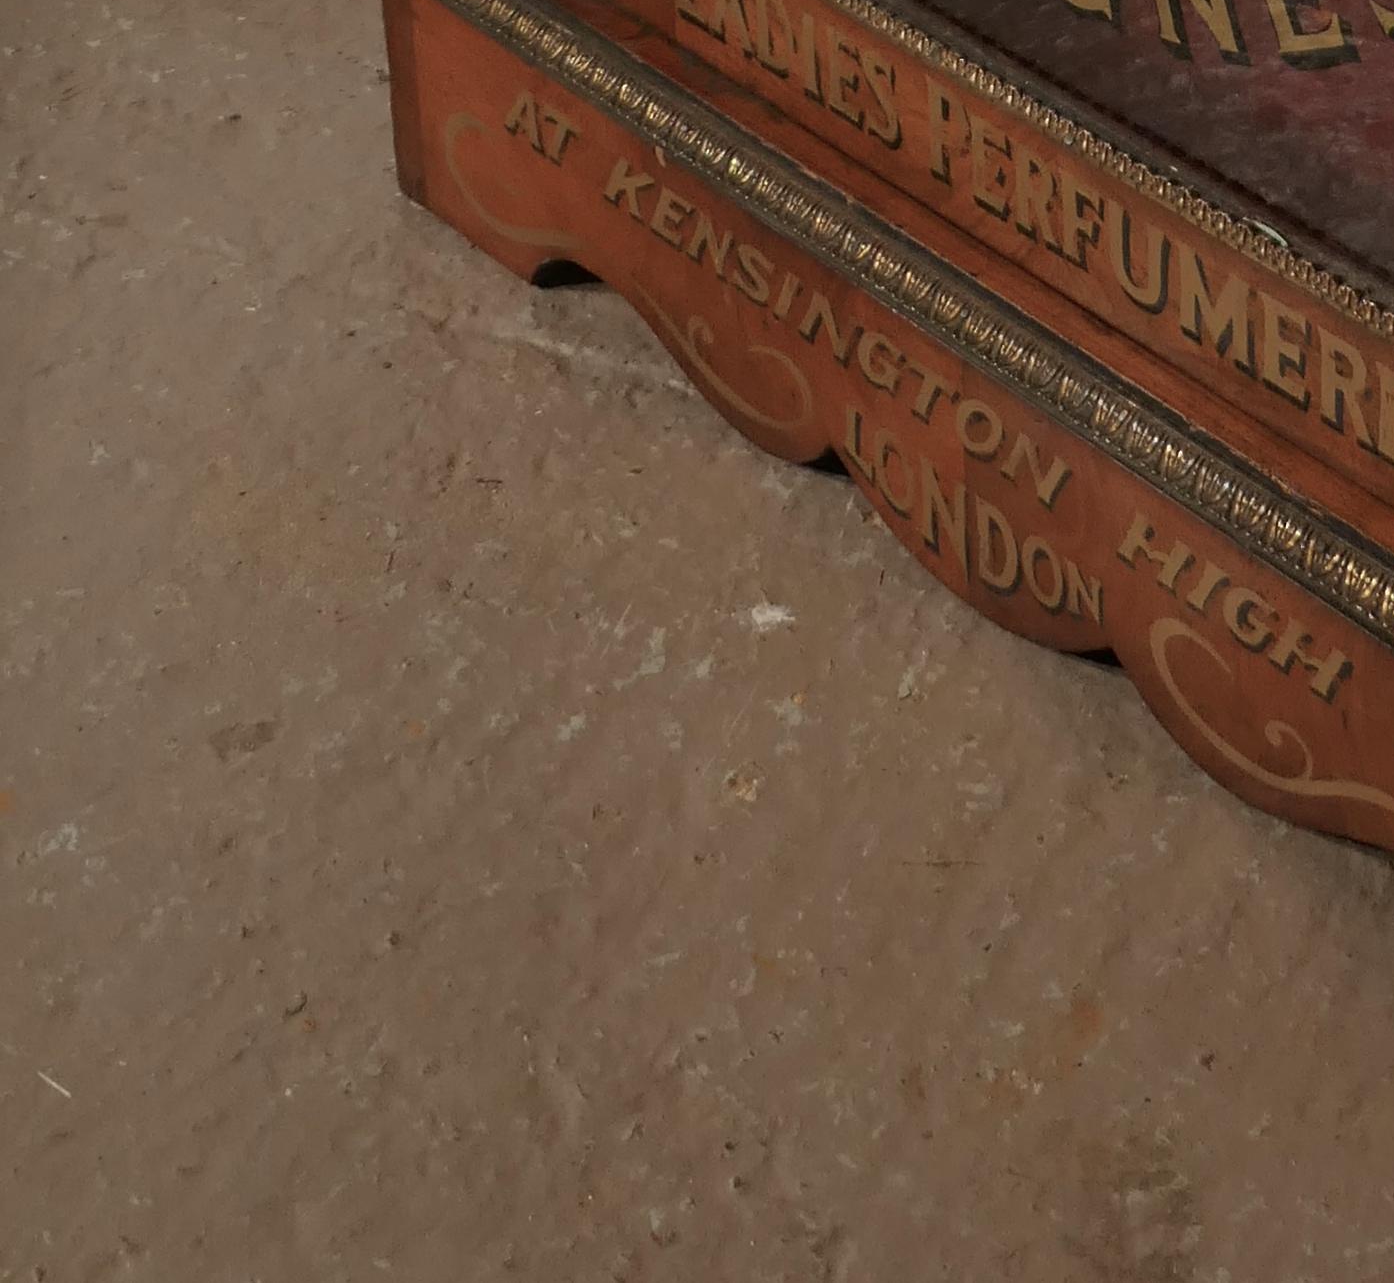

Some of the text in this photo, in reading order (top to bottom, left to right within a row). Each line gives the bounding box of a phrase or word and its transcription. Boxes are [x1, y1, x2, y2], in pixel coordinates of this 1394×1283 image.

[504, 90, 577, 166] AT
[604, 155, 1074, 510] KENSINGTON
[1116, 513, 1355, 704] HIGH
[842, 404, 1107, 624] LONDON
